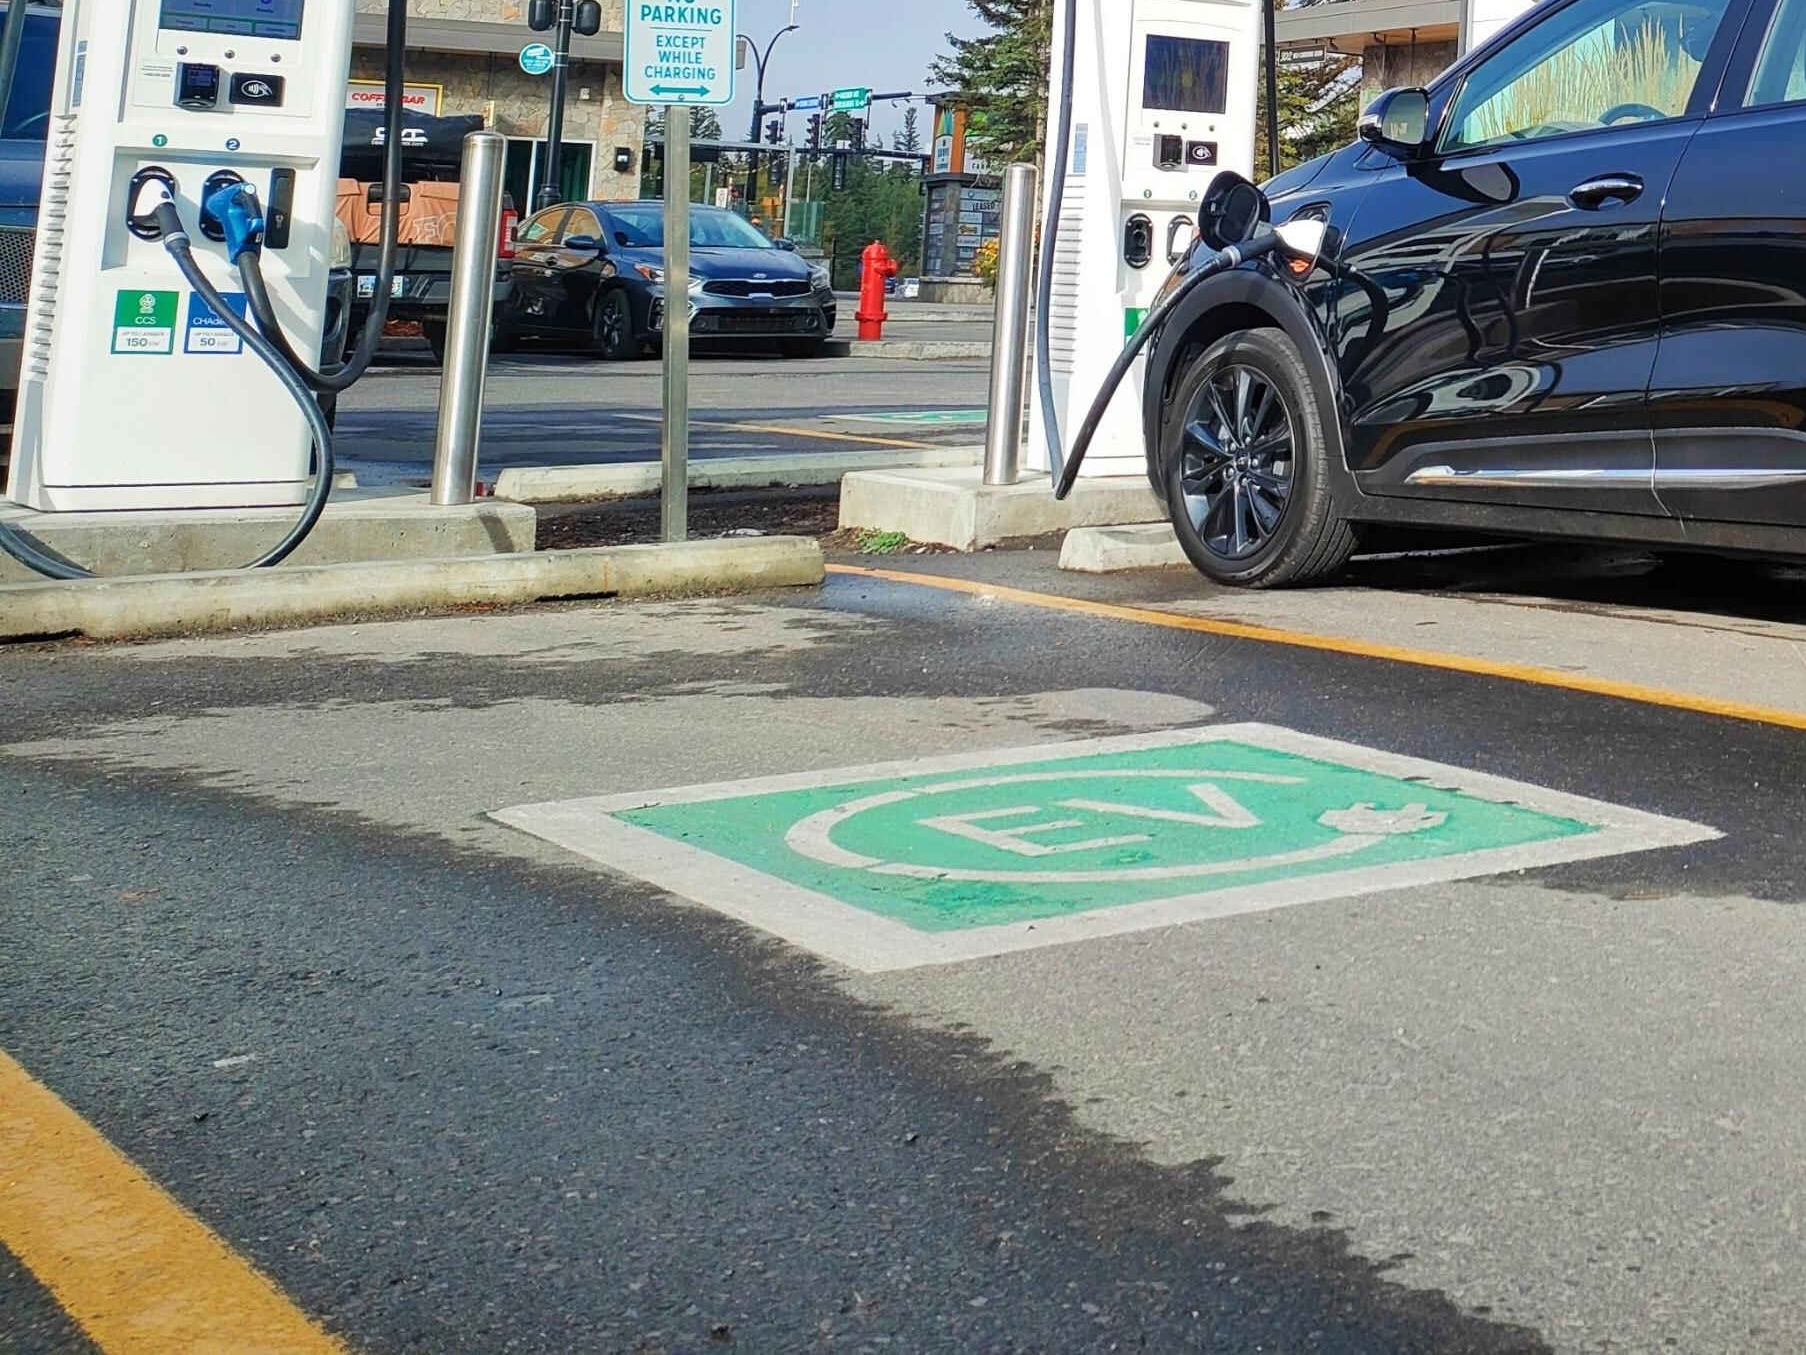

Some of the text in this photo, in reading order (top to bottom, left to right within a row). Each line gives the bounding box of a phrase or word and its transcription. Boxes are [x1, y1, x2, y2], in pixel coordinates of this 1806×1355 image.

[640, 5, 722, 25] PARKING
[656, 35, 706, 49] EXCEPT
[658, 51, 702, 64] WHILE
[644, 65, 716, 80] CHARGING
[972, 201, 995, 211] LEASED
[135, 316, 156, 325] CCS
[127, 337, 148, 347] 150
[200, 337, 215, 346] 50
[914, 783, 1263, 857] EV
